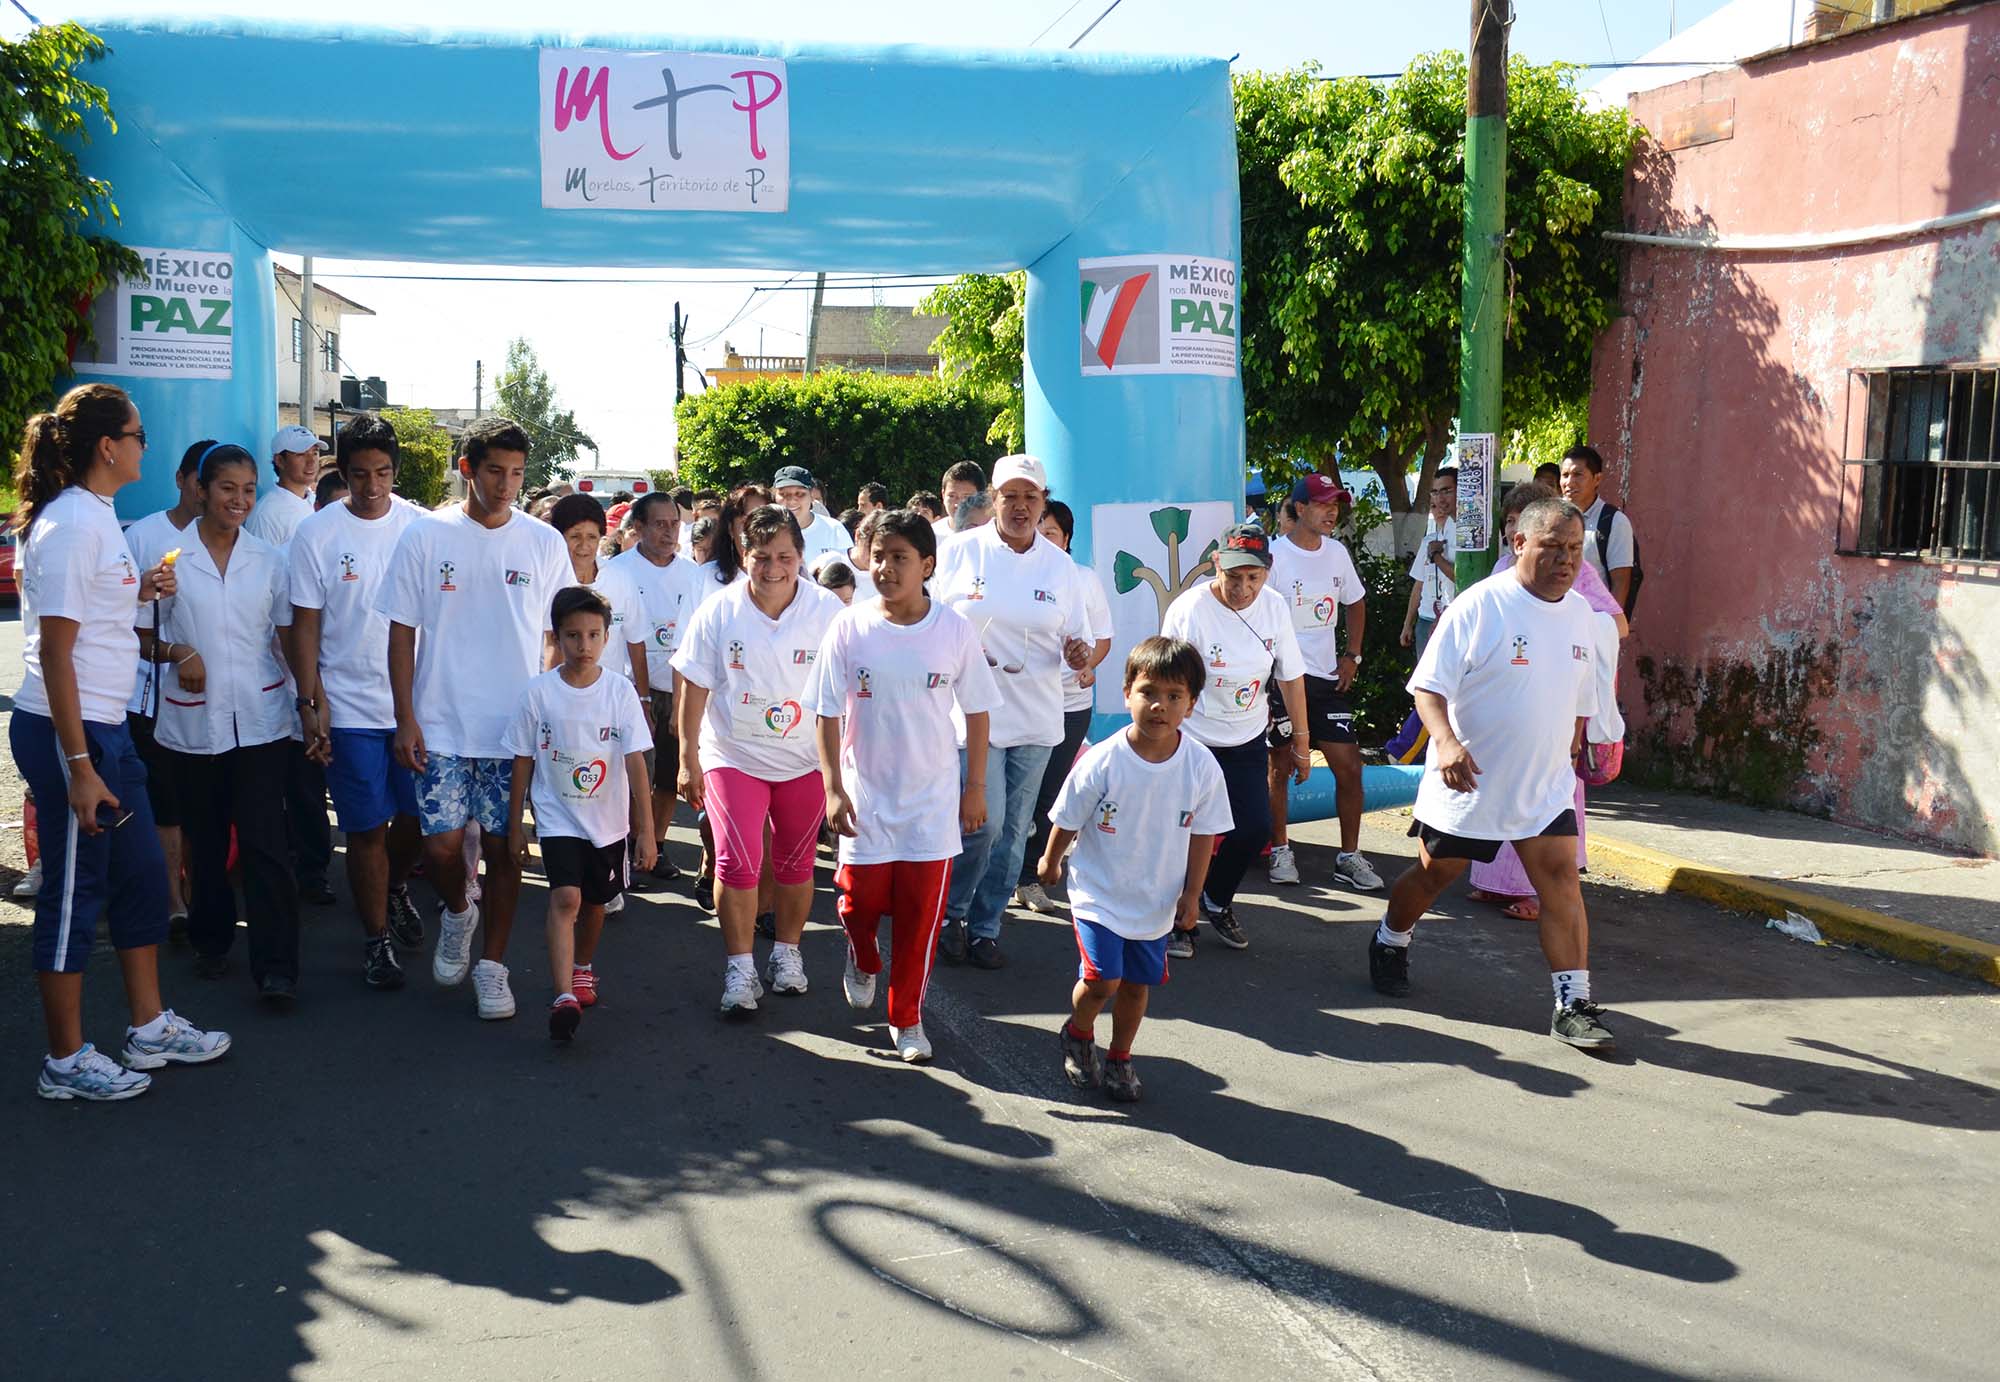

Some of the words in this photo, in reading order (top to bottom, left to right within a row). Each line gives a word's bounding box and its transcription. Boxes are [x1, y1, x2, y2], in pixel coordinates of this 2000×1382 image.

[565, 167, 635, 201] Morelos,
[723, 179, 740, 192] de
[745, 168, 775, 204] Paz
[1170, 259, 1235, 286] MÉXICO
[155, 278, 219, 295] Mueve
[223, 286, 232, 295] la
[1190, 283, 1229, 299] Mueve
[131, 294, 232, 337] PAZ
[1171, 298, 1235, 337] PAZ
[773, 714, 792, 723] 013
[581, 774, 598, 783] 053
